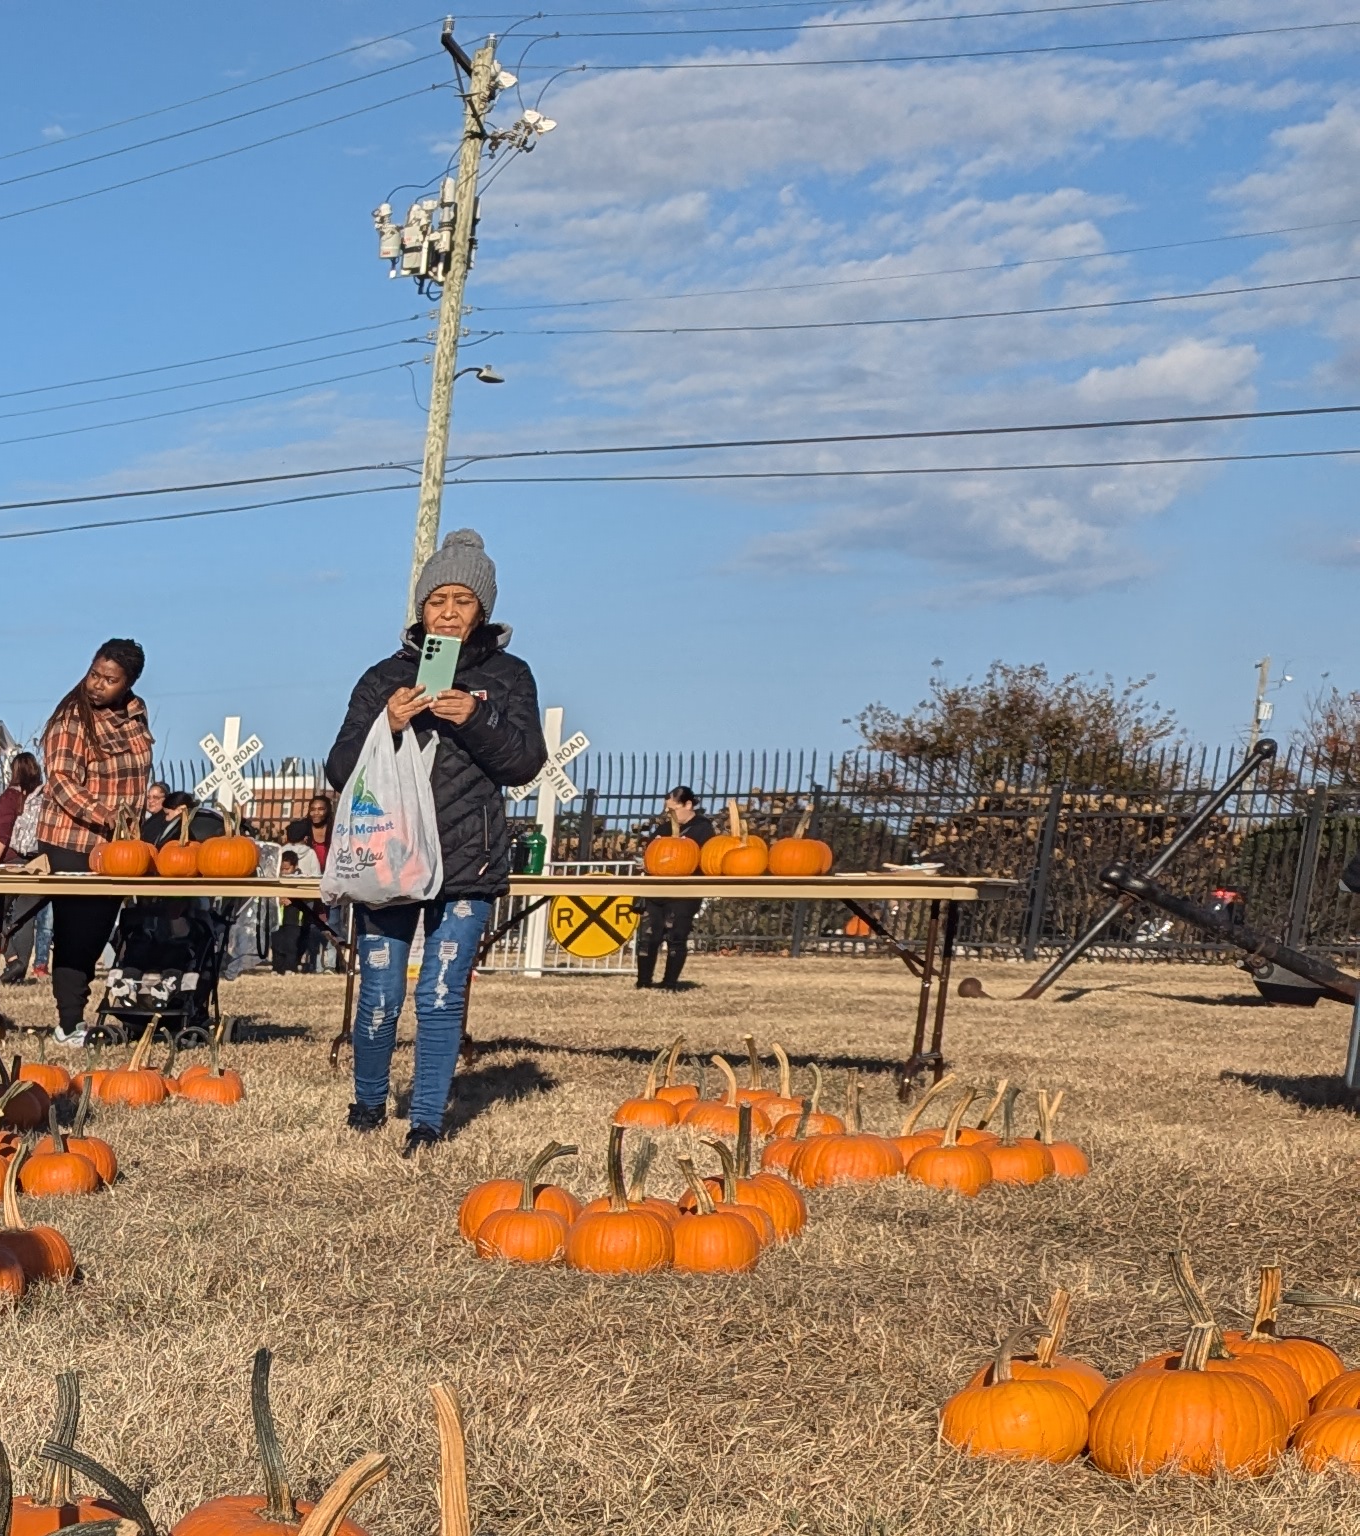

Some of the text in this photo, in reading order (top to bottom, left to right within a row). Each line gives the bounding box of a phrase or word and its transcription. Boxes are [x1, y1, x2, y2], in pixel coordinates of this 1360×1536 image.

[554, 735, 585, 765] ROAD
[196, 739, 260, 798] RAIL ROAD
[204, 738, 250, 801] CROSSING
[355, 846, 384, 871] You
[556, 903, 634, 929] R R
